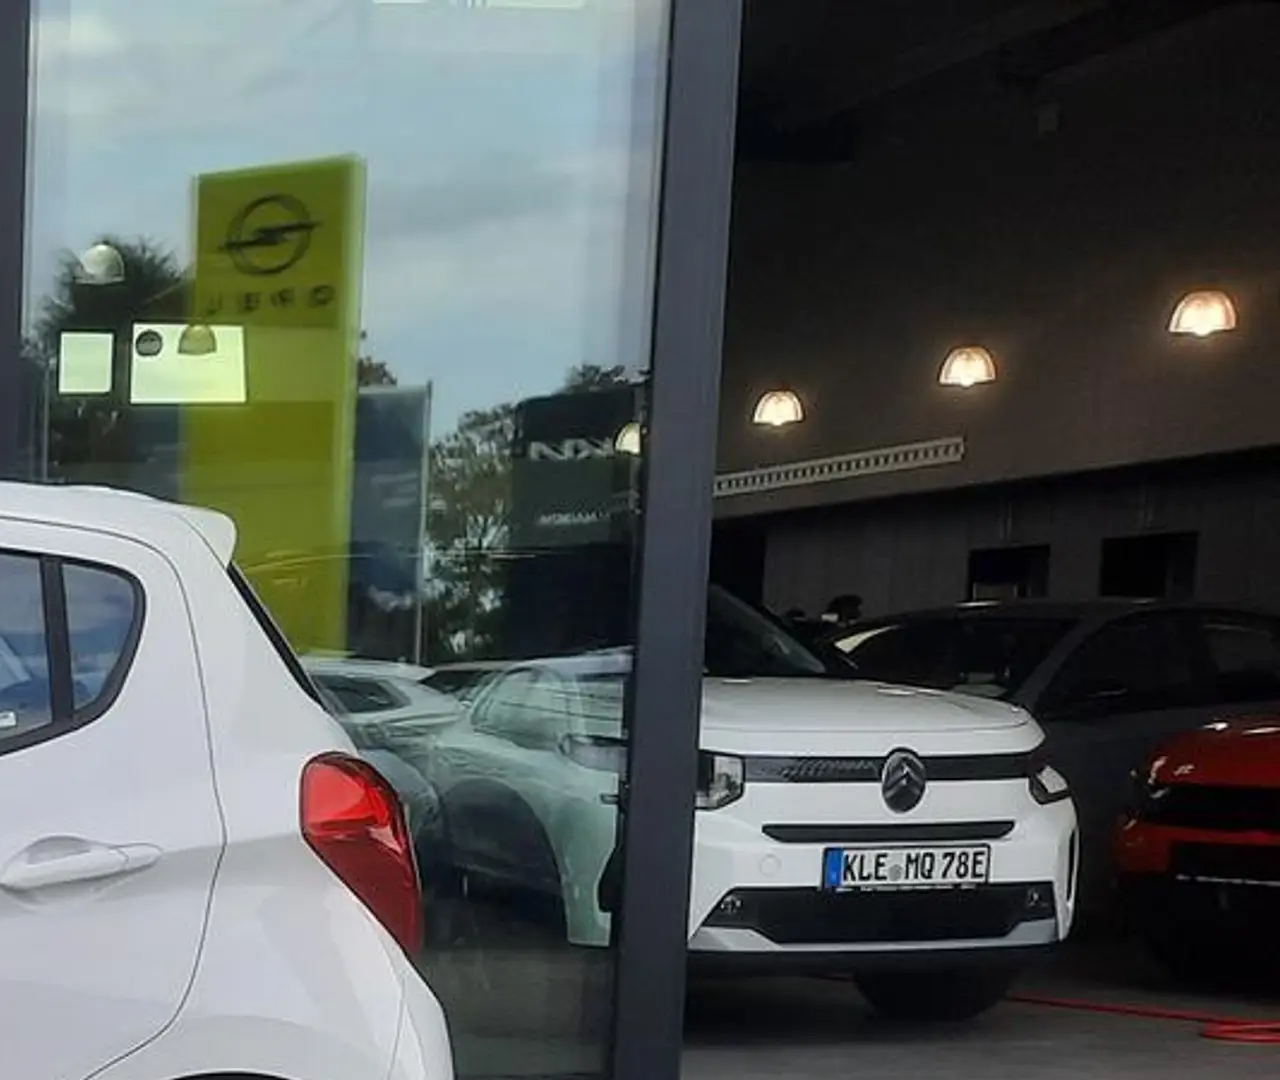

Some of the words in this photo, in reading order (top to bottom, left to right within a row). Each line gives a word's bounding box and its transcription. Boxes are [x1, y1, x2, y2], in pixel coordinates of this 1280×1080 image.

[843, 853, 888, 881] KLE
[905, 852, 935, 880] MQ
[941, 851, 985, 879] 78E
